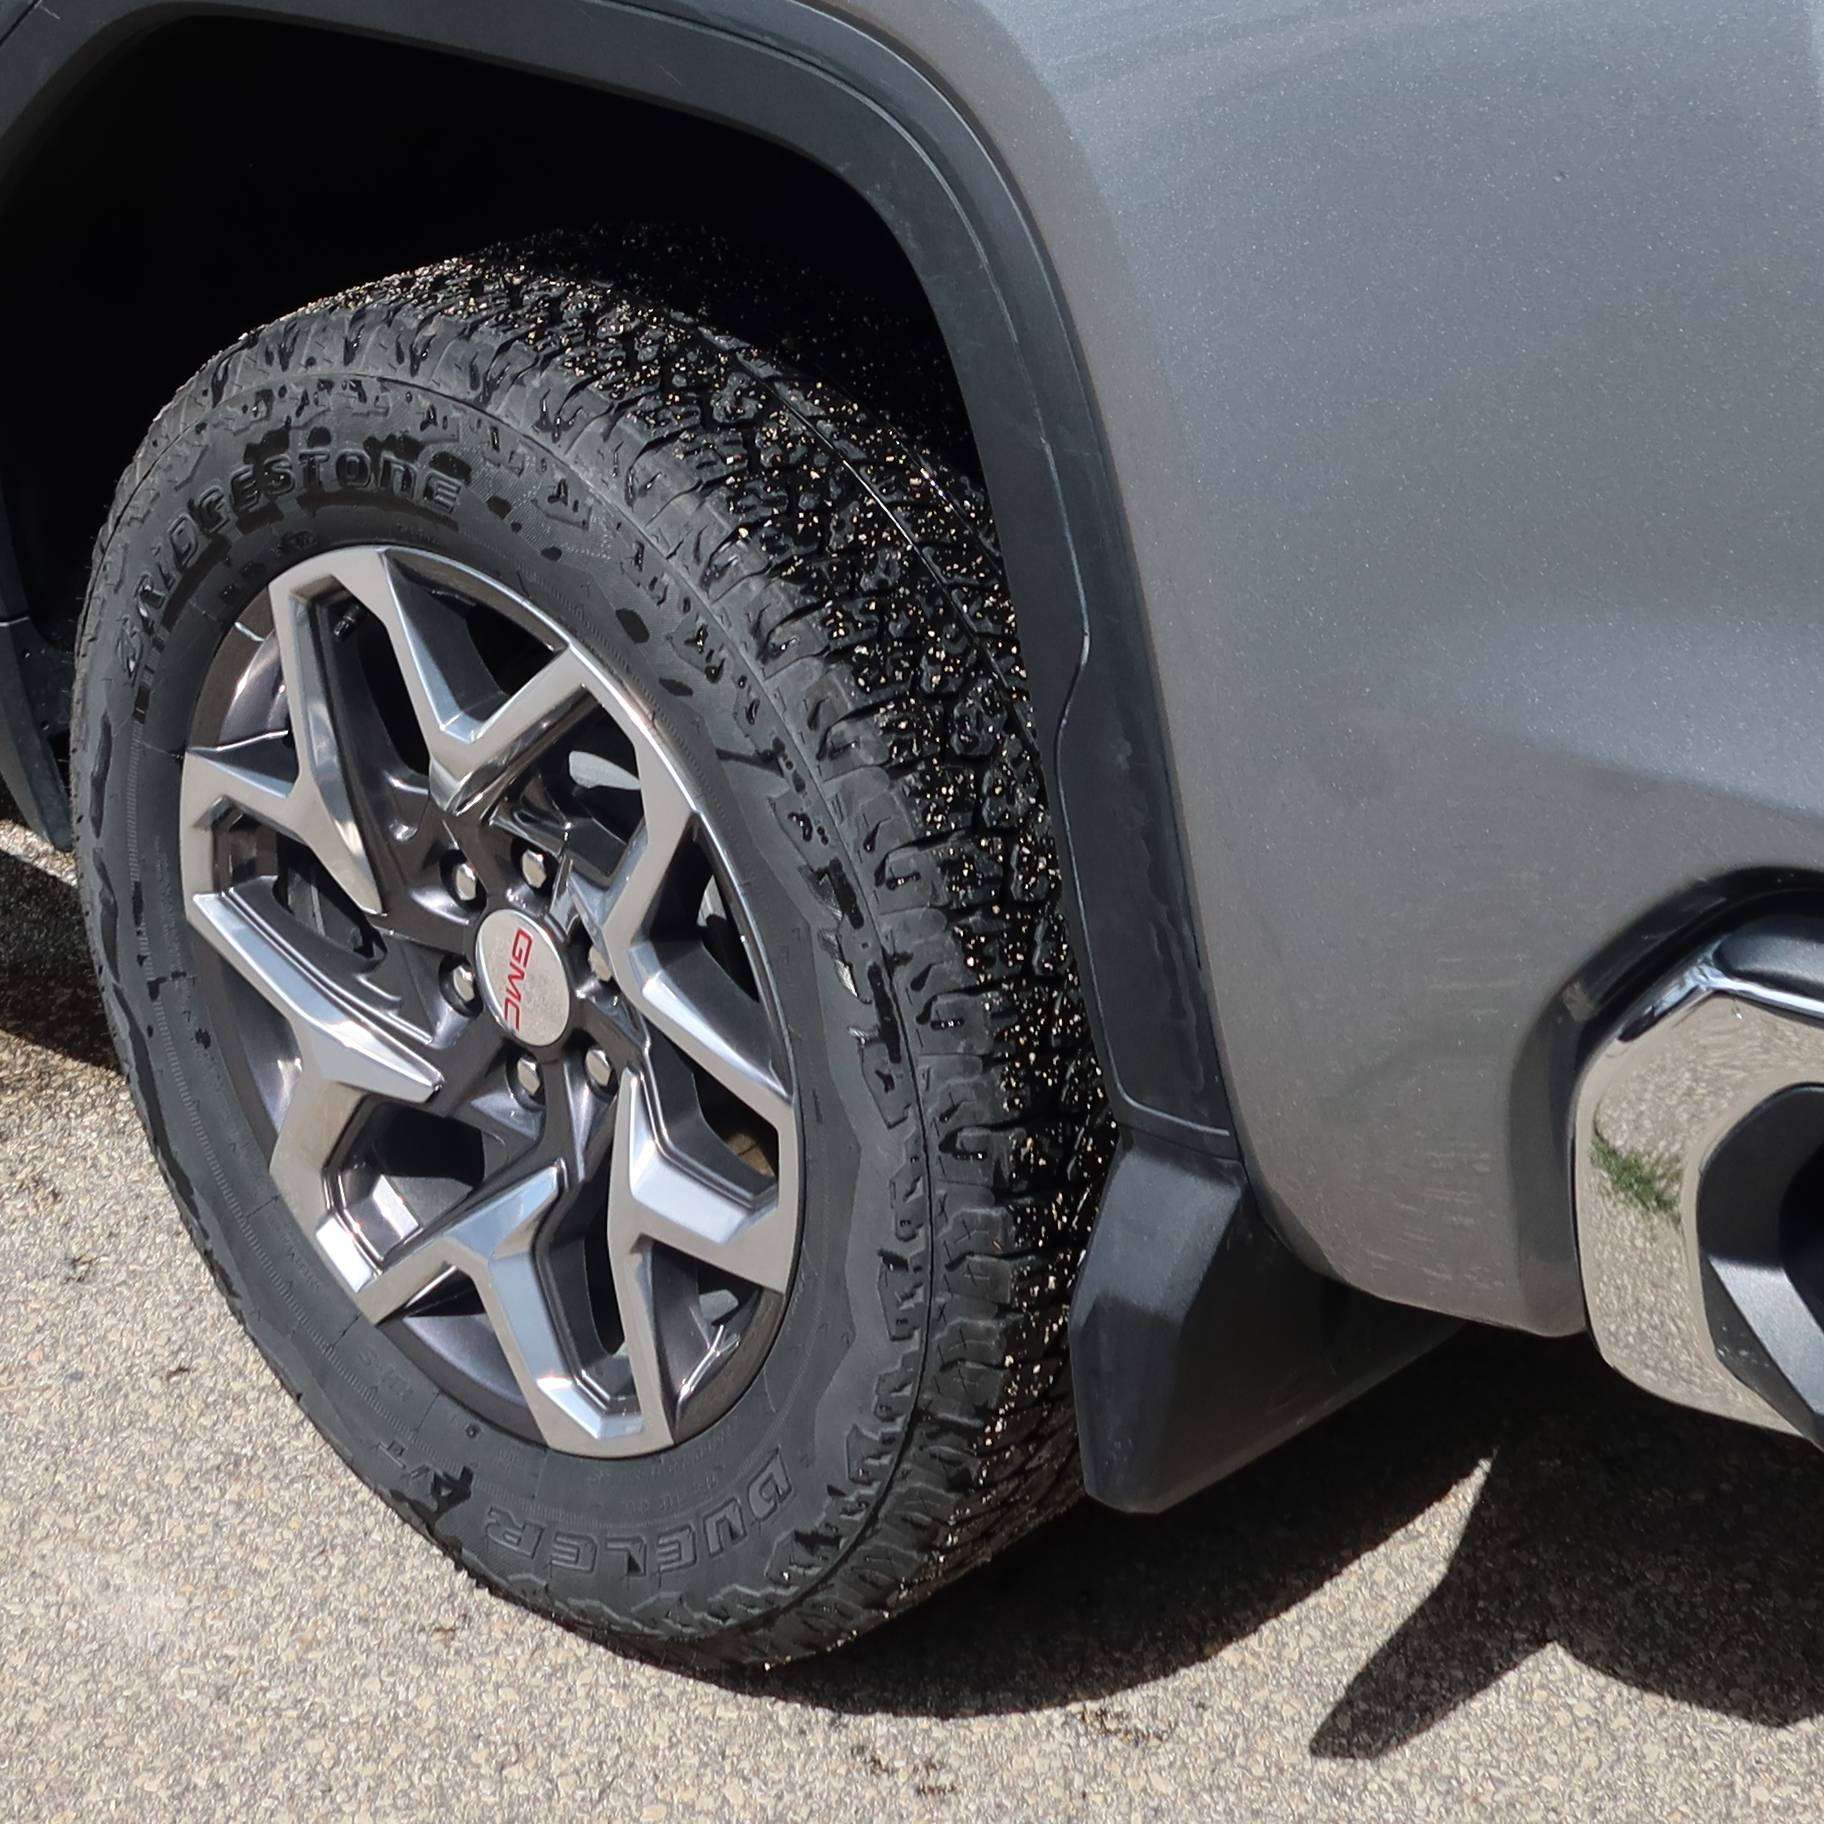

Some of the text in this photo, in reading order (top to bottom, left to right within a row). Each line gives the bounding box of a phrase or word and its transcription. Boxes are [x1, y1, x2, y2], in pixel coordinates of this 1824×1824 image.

[116, 448, 463, 680] BRIDGESTONE
[503, 927, 533, 1033] GMC
[484, 1445, 792, 1575] DUELER
